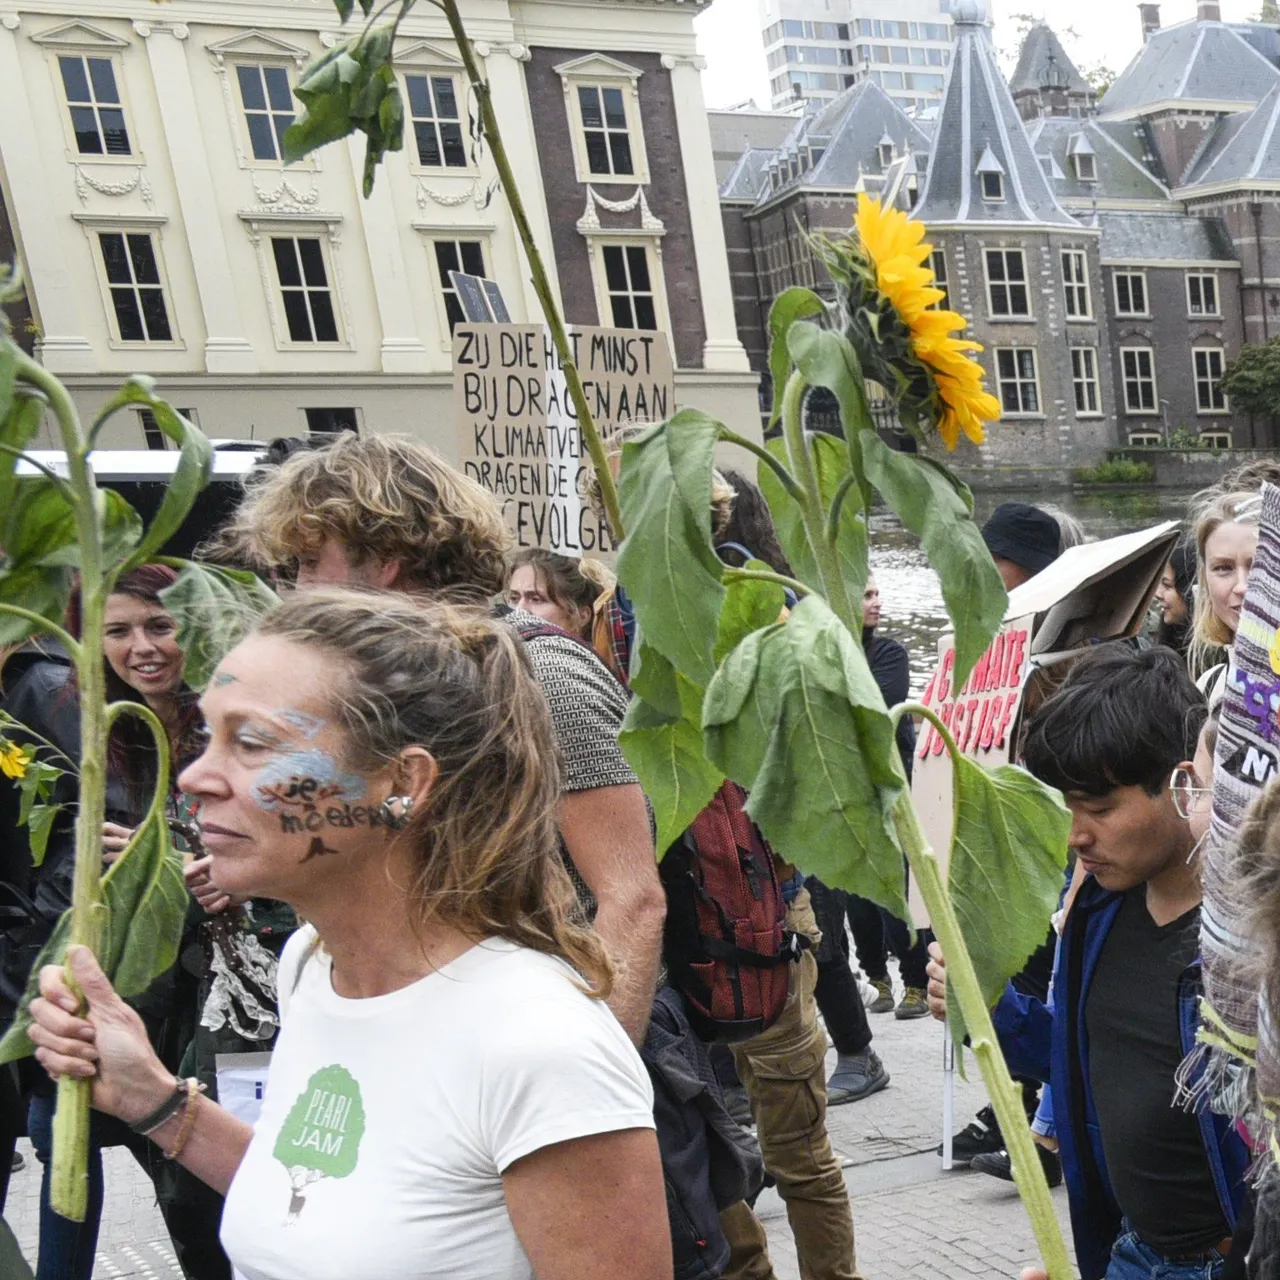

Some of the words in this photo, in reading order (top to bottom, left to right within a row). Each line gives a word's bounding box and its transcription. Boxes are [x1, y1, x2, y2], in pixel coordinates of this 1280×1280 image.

[456, 332, 490, 369] ZIJ
[500, 332, 538, 368] DIE
[590, 335, 653, 375] MINST
[617, 383, 667, 422] AAN
[546, 462, 568, 499] DE
[938, 630, 1027, 702] CMATE
[304, 1089, 352, 1133] PEARL
[291, 1126, 344, 1157] JAM
